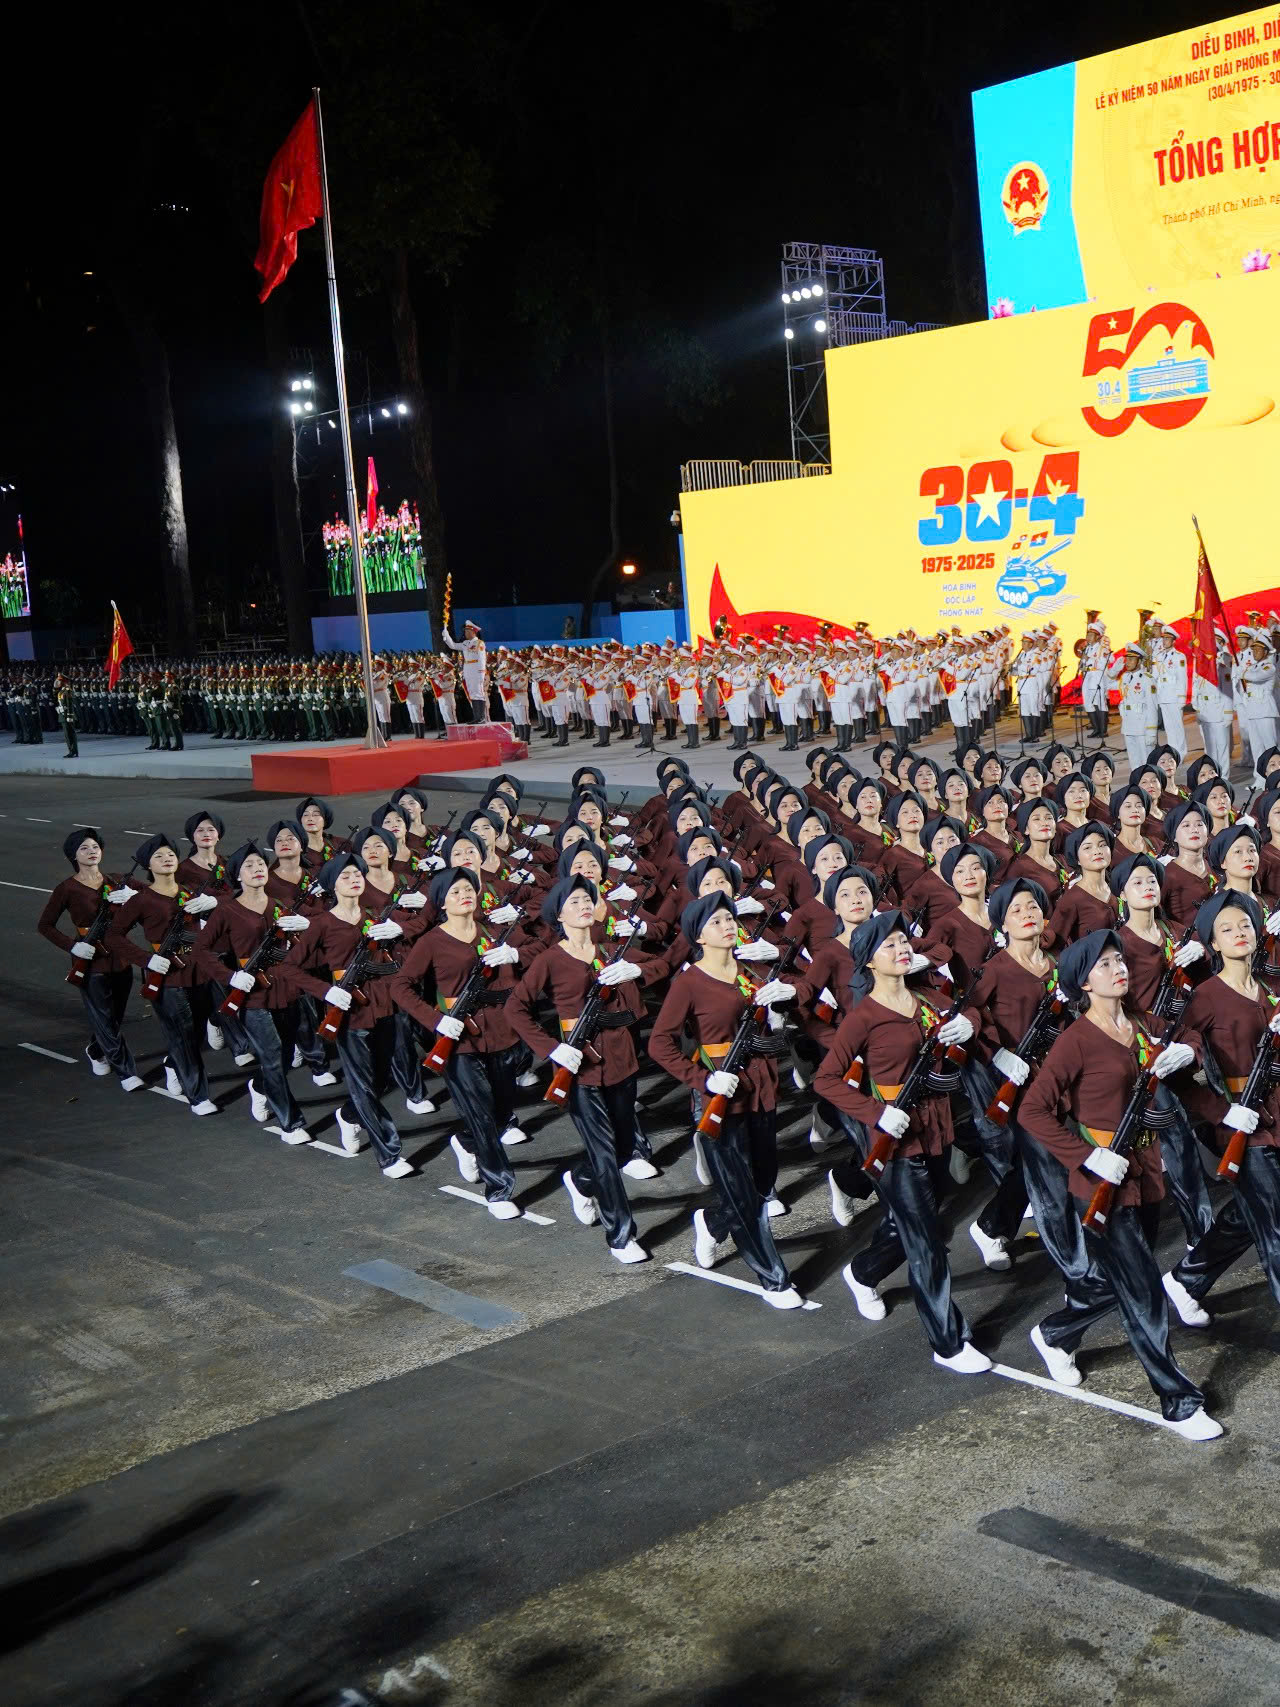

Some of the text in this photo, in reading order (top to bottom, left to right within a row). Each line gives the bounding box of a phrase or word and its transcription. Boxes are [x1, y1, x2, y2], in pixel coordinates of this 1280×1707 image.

[1224, 26, 1259, 51] BINH,
[1121, 84, 1145, 103] NIỆM
[1147, 82, 1158, 96] 50
[1161, 75, 1183, 92] NĂM
[1185, 66, 1210, 87] NGÀY
[1213, 58, 1233, 79] GIẢI
[1236, 52, 1270, 73] PHÓNG
[1208, 75, 1260, 101] (30/4/1975
[1153, 130, 1224, 187] TỔNG
[918, 451, 1086, 547] 30-4
